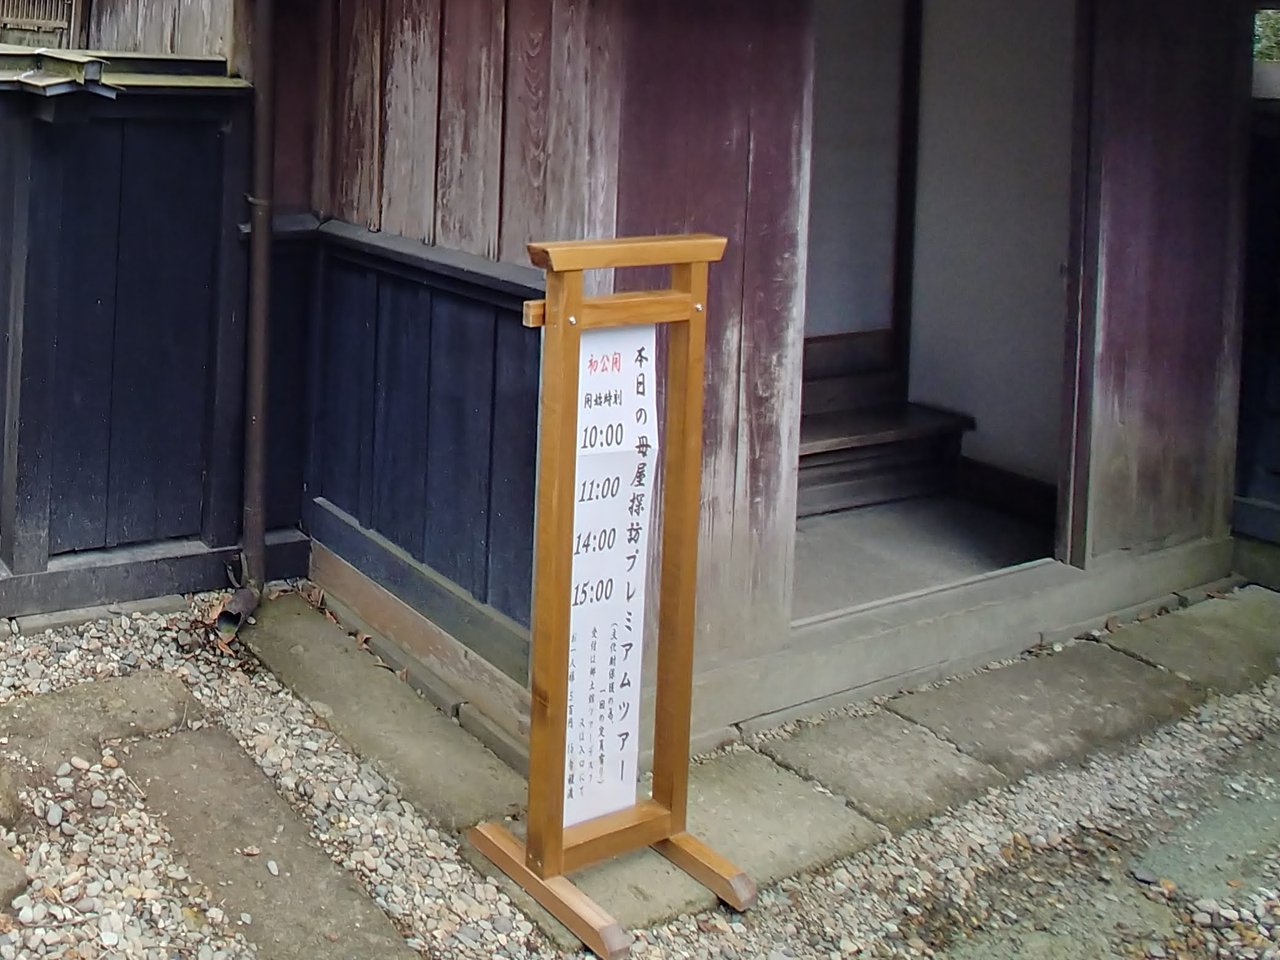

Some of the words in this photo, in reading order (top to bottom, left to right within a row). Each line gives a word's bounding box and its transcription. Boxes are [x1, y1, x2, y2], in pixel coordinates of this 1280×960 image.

[587, 351, 622, 377] 初公開
[583, 389, 623, 410] 開始時刻
[580, 422, 624, 450] 10:00
[578, 476, 621, 503] 11:00
[573, 527, 617, 556] 14:00
[617, 346, 652, 782] 本日の母屋探訪プレミアムツアー
[571, 578, 614, 607] 15:00
